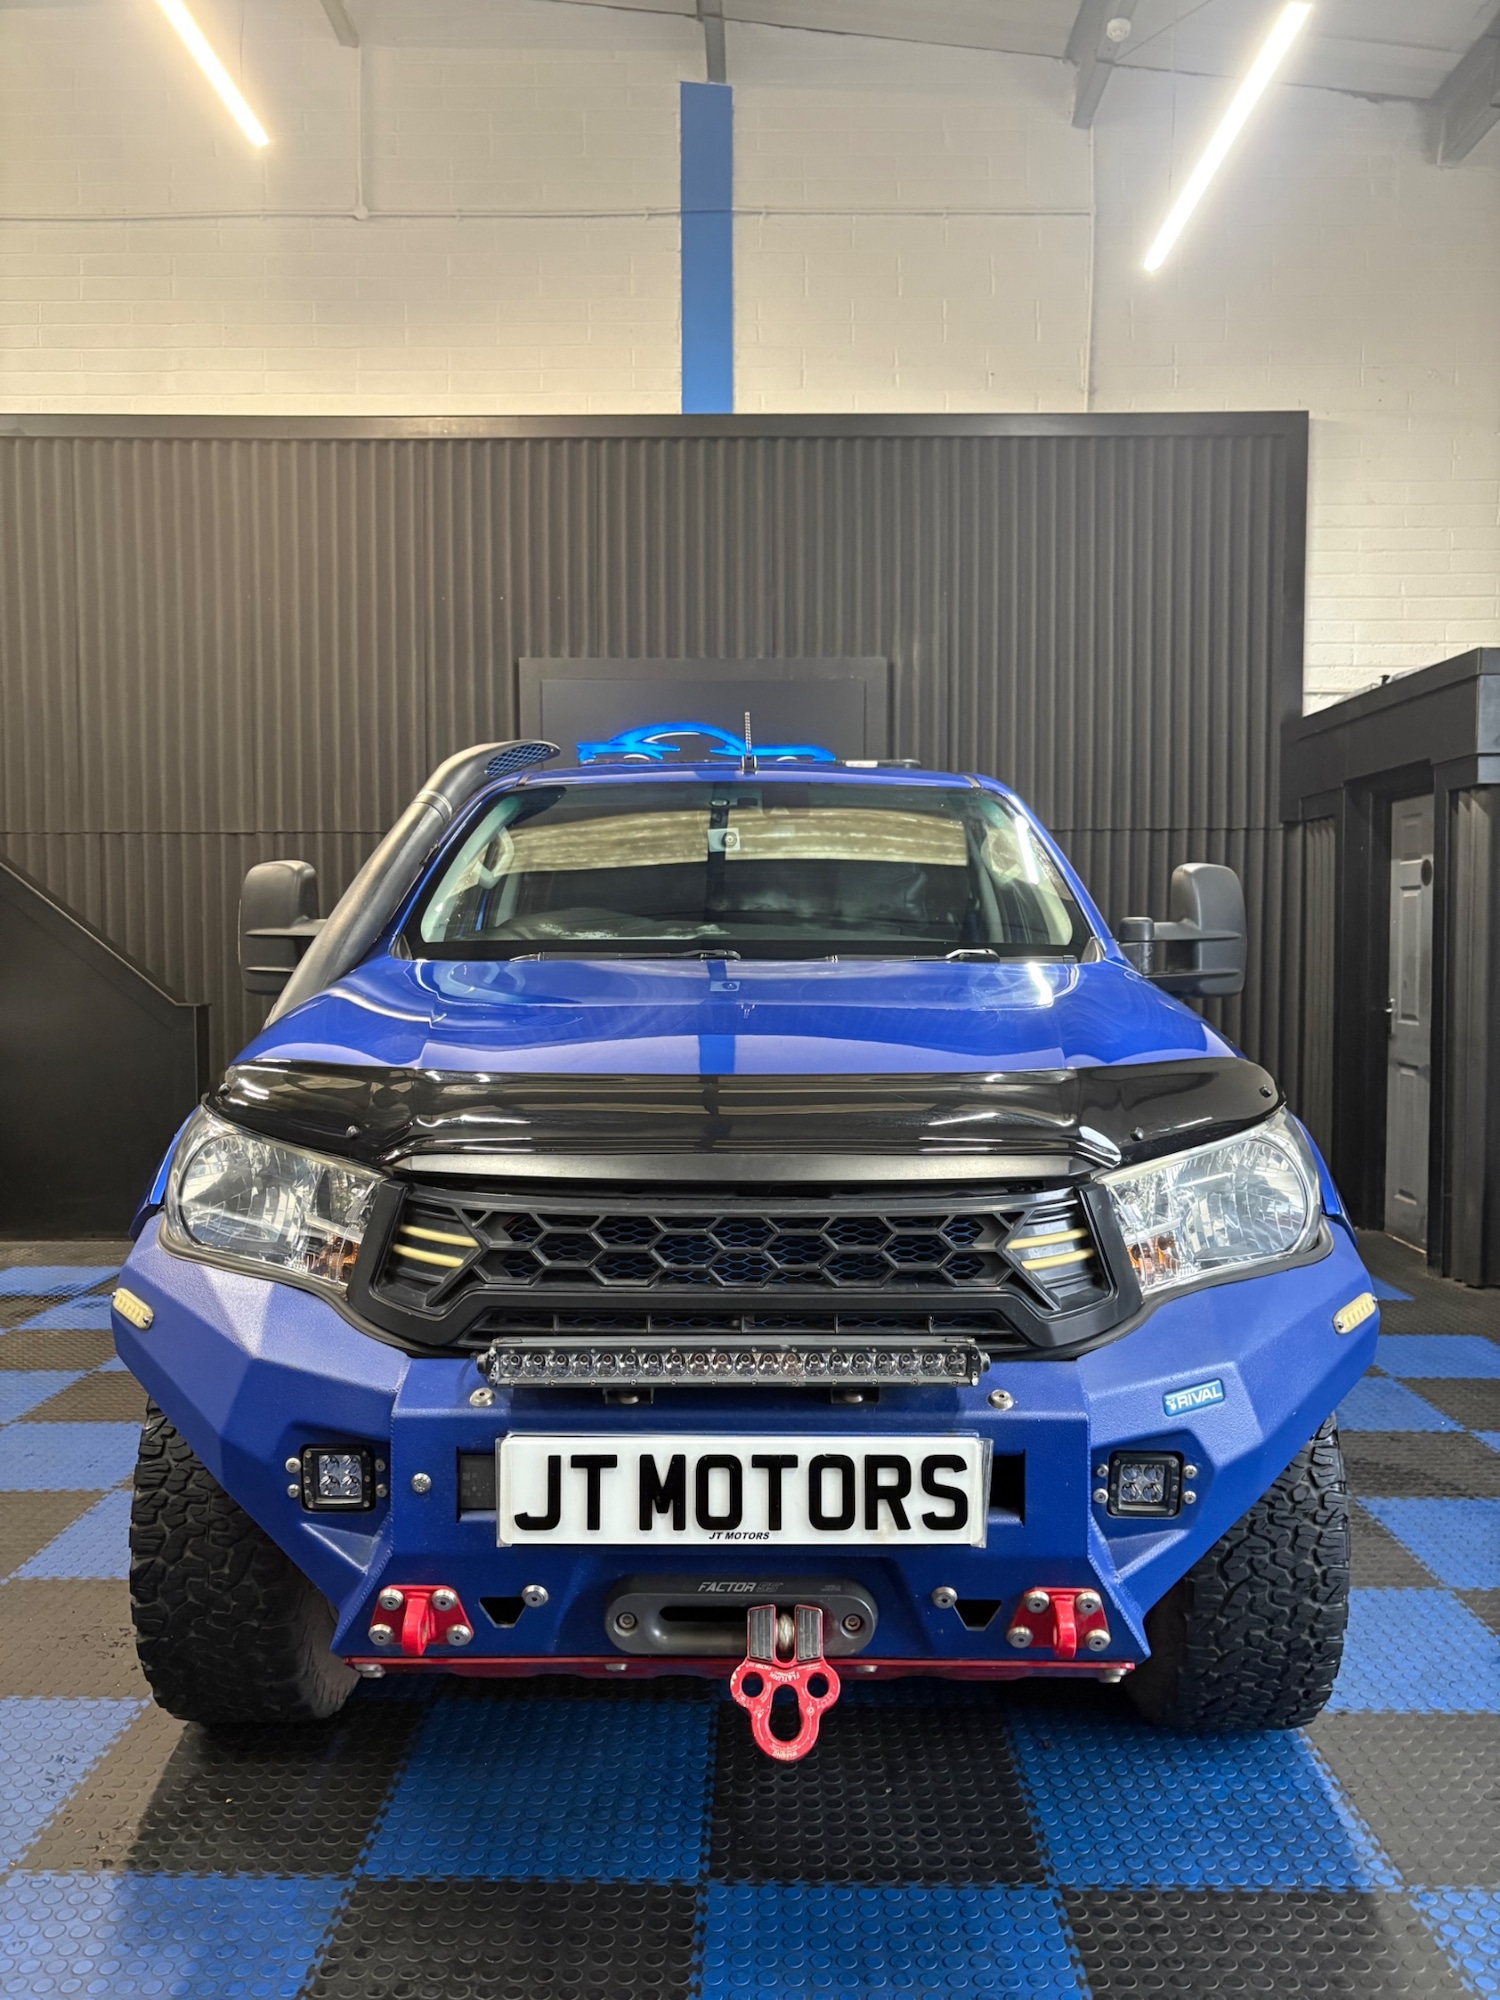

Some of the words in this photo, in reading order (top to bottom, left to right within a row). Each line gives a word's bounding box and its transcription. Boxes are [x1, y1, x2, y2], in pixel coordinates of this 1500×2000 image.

[1177, 1386, 1223, 1409] RIVAL
[514, 1454, 618, 1531] JT
[638, 1454, 969, 1531] MOTORS
[708, 1532, 723, 1540] JT
[725, 1532, 770, 1540] MOTORS
[697, 1581, 757, 1592] FACTOR
